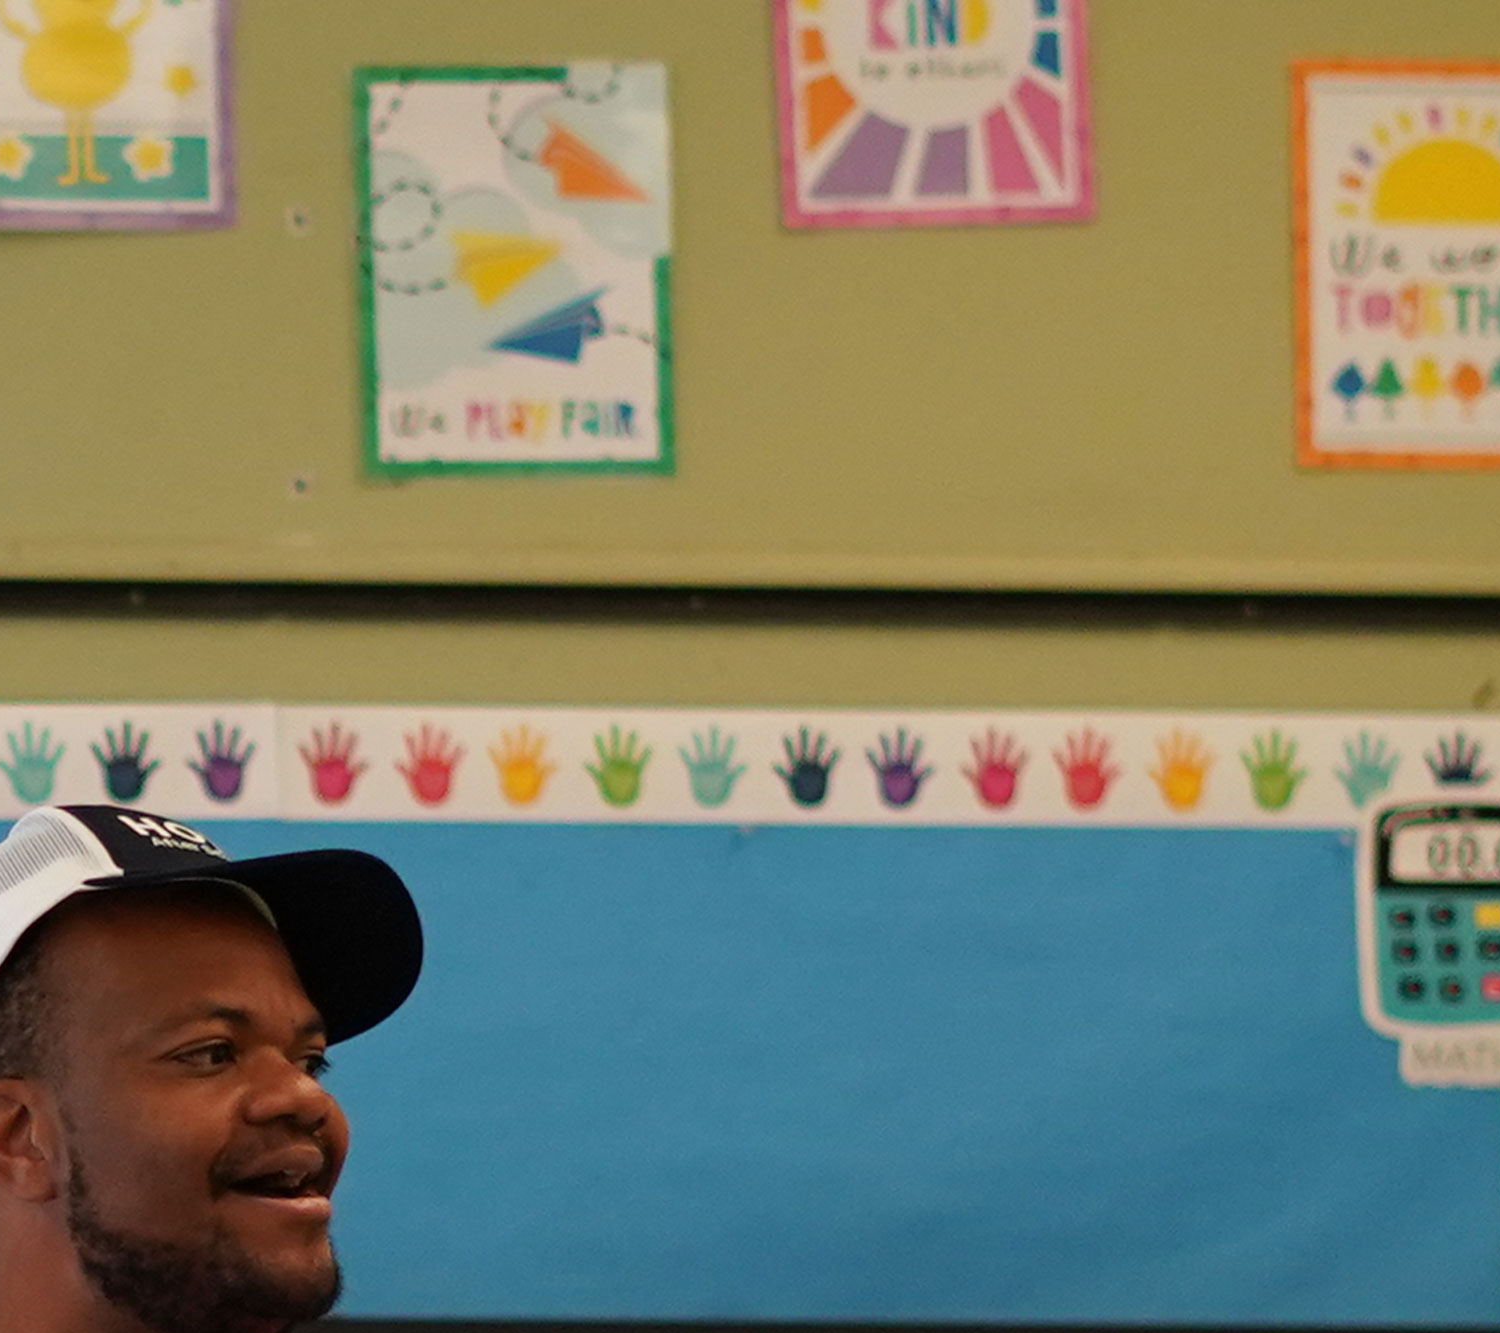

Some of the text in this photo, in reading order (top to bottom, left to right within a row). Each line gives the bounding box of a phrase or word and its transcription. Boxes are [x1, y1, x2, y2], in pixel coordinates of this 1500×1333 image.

[1328, 233, 1403, 277] We
[388, 403, 446, 438] We
[463, 400, 548, 444] PLAY
